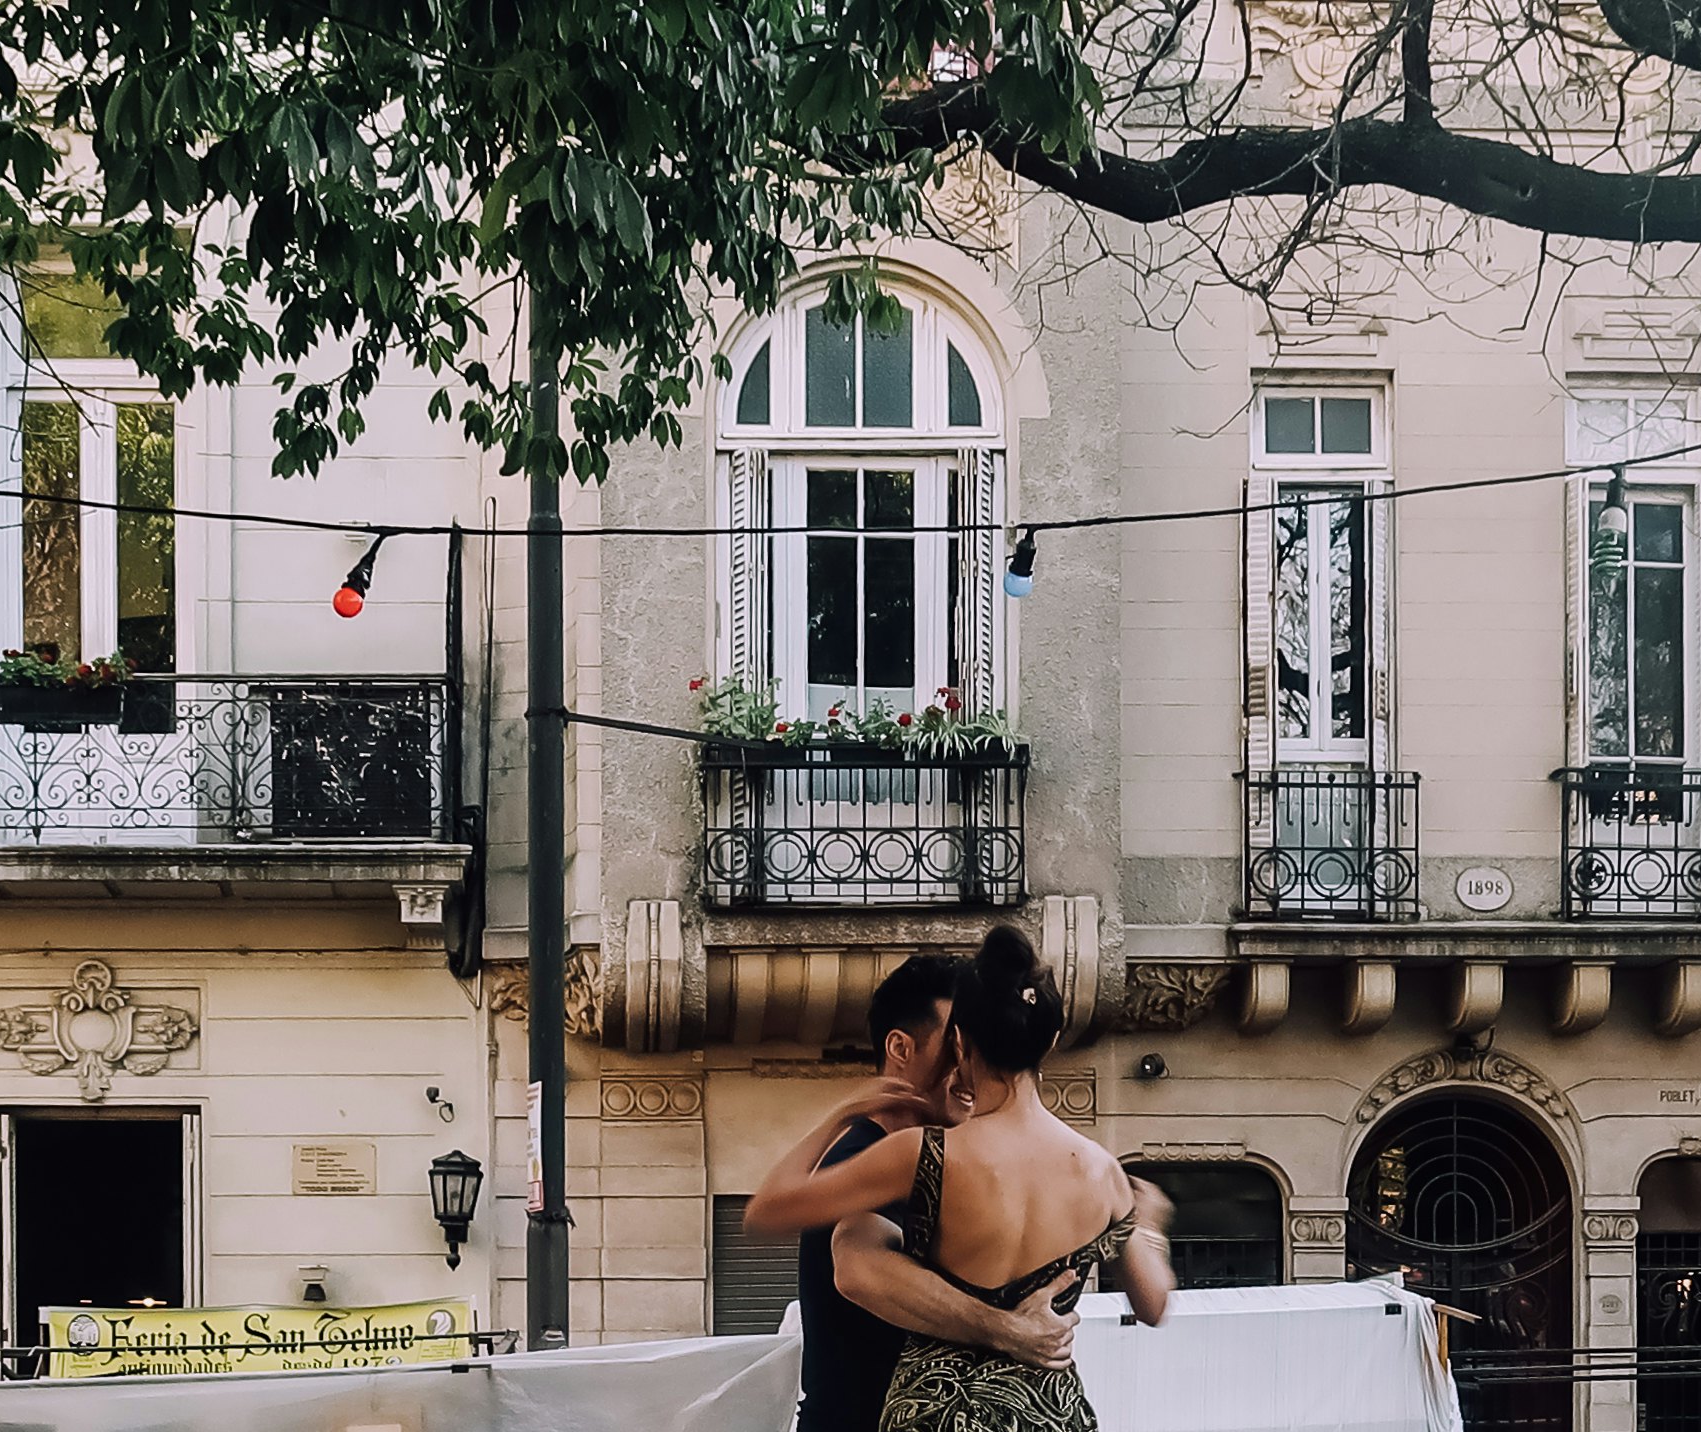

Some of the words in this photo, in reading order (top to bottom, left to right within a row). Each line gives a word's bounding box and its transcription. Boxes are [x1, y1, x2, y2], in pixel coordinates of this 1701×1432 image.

[1467, 880, 1504, 896] 1898
[100, 1314, 190, 1365] Feria
[201, 1319, 231, 1358] de
[236, 1312, 306, 1362] San
[314, 1309, 414, 1355] Telmo
